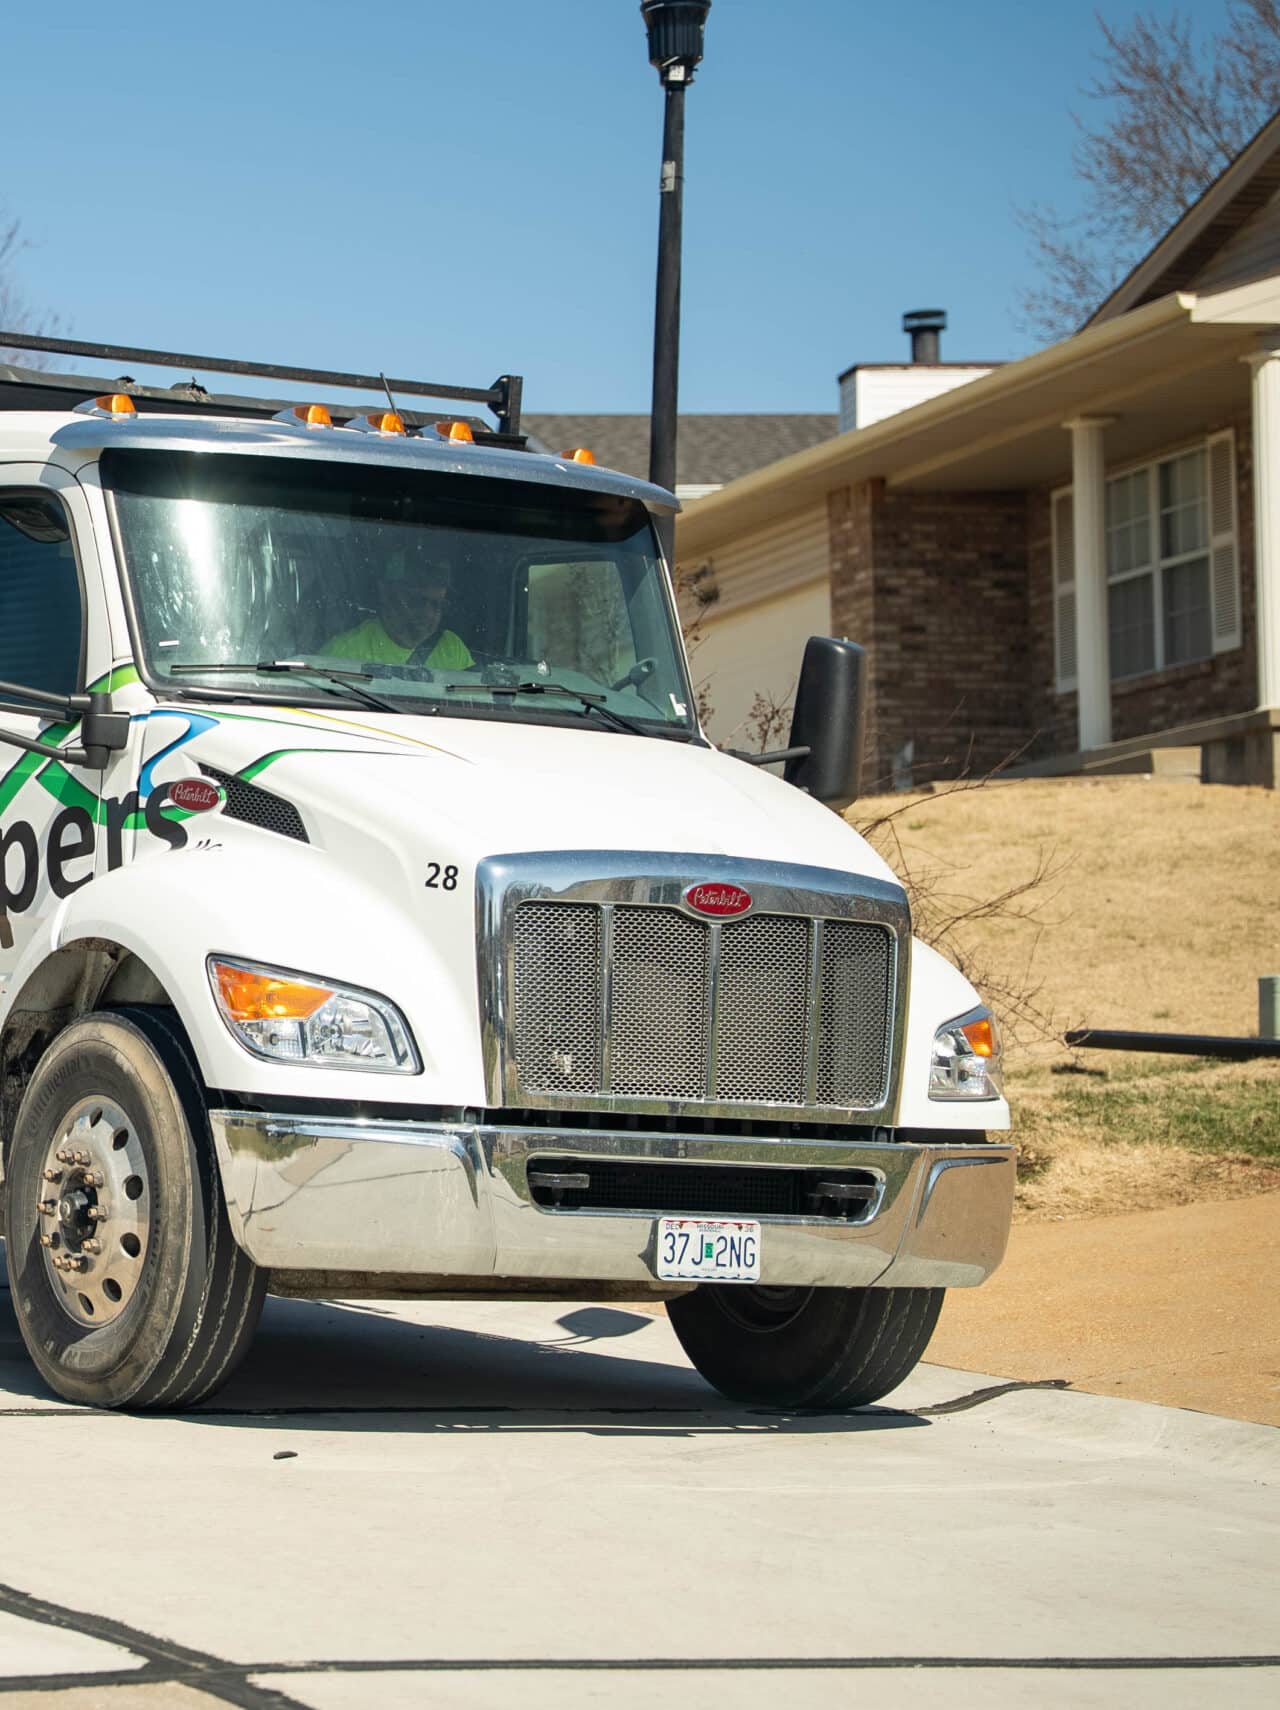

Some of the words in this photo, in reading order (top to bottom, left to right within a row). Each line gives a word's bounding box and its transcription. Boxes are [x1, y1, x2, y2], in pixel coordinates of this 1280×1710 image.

[174, 783, 216, 804] Peterbilt
[425, 862, 459, 891] 28
[694, 887, 747, 907] Peterbilt
